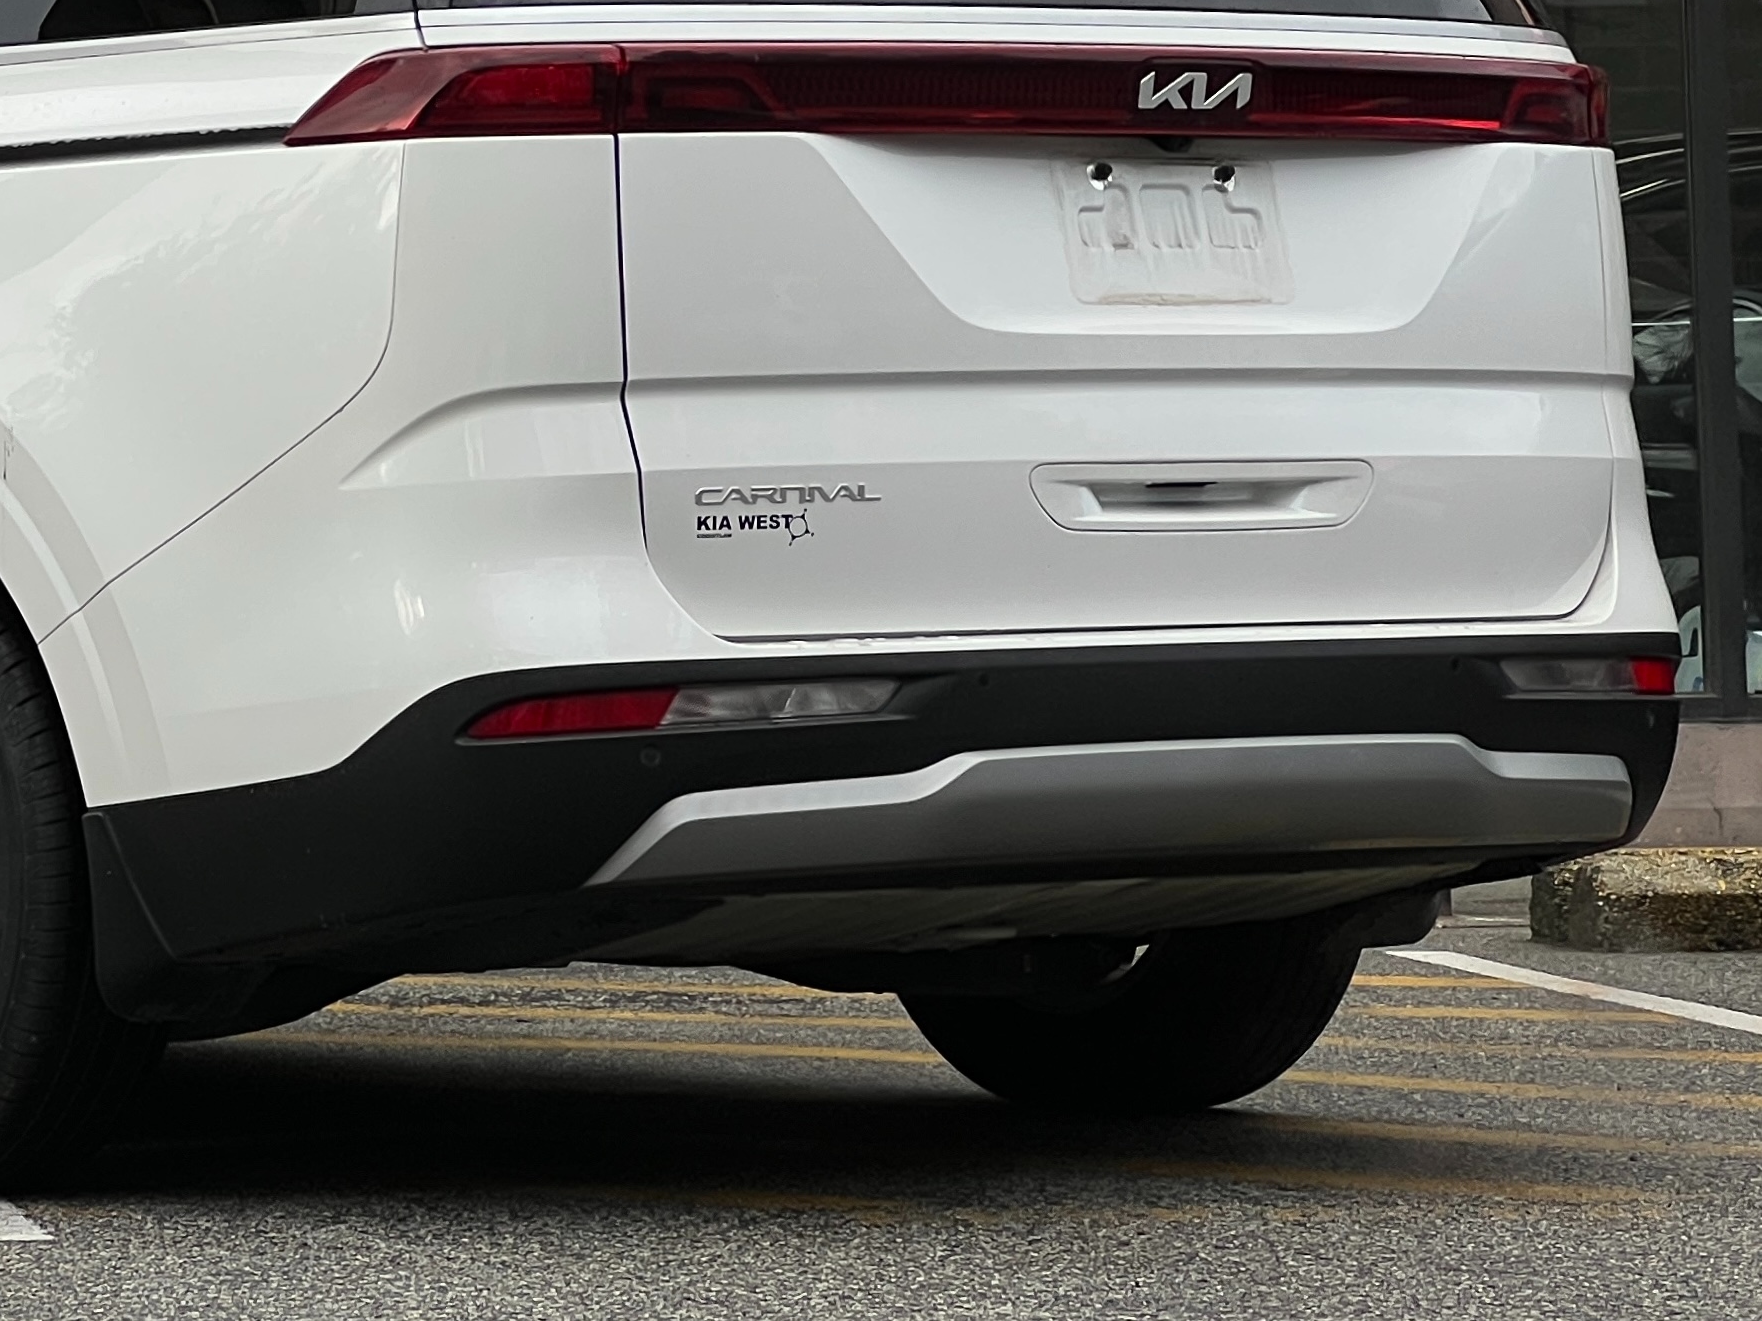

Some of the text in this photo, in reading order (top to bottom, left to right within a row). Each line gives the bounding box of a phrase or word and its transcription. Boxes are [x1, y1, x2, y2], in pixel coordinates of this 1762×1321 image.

[1138, 71, 1253, 110] KIA
[695, 482, 882, 506] CARNIVAL
[697, 514, 794, 531] KIA WEST
